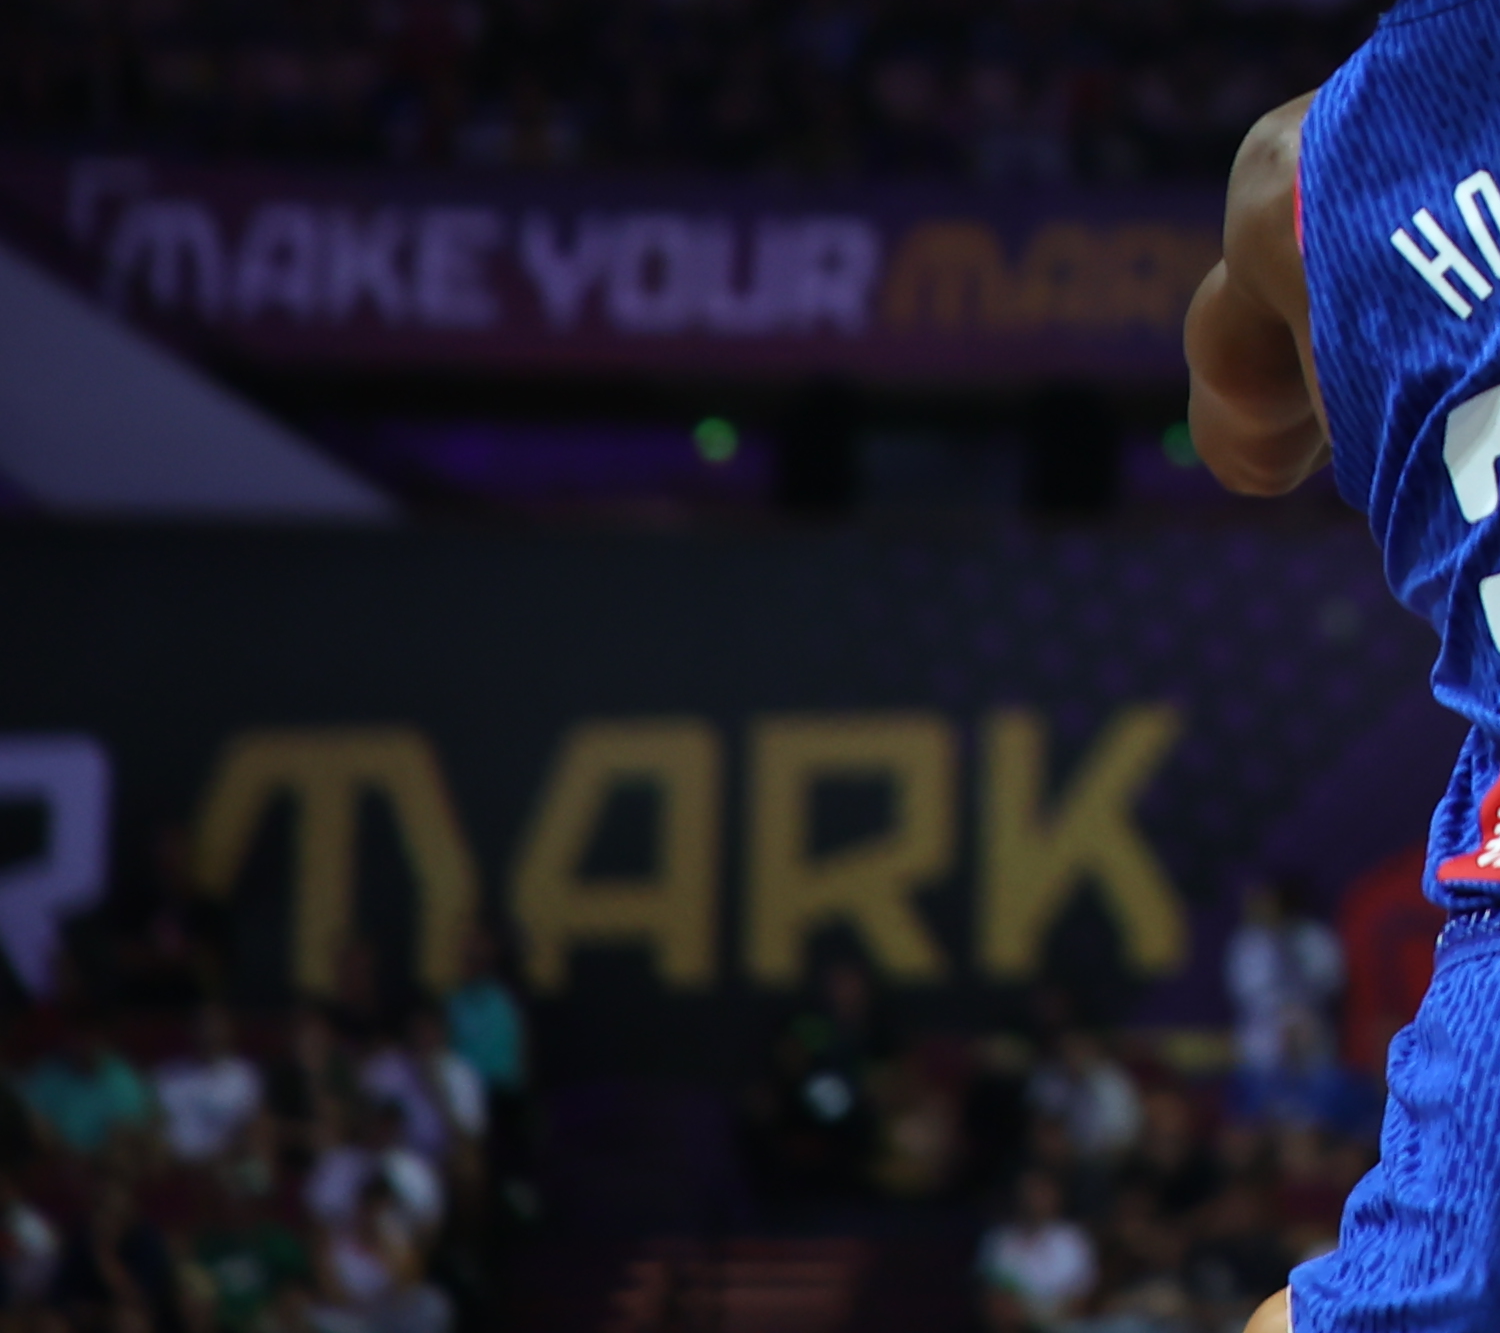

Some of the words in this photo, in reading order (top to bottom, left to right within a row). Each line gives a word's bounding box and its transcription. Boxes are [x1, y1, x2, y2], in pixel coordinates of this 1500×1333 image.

[102, 197, 502, 329] MAKE
[516, 203, 882, 336] YOUR
[185, 700, 1188, 998] MARK
